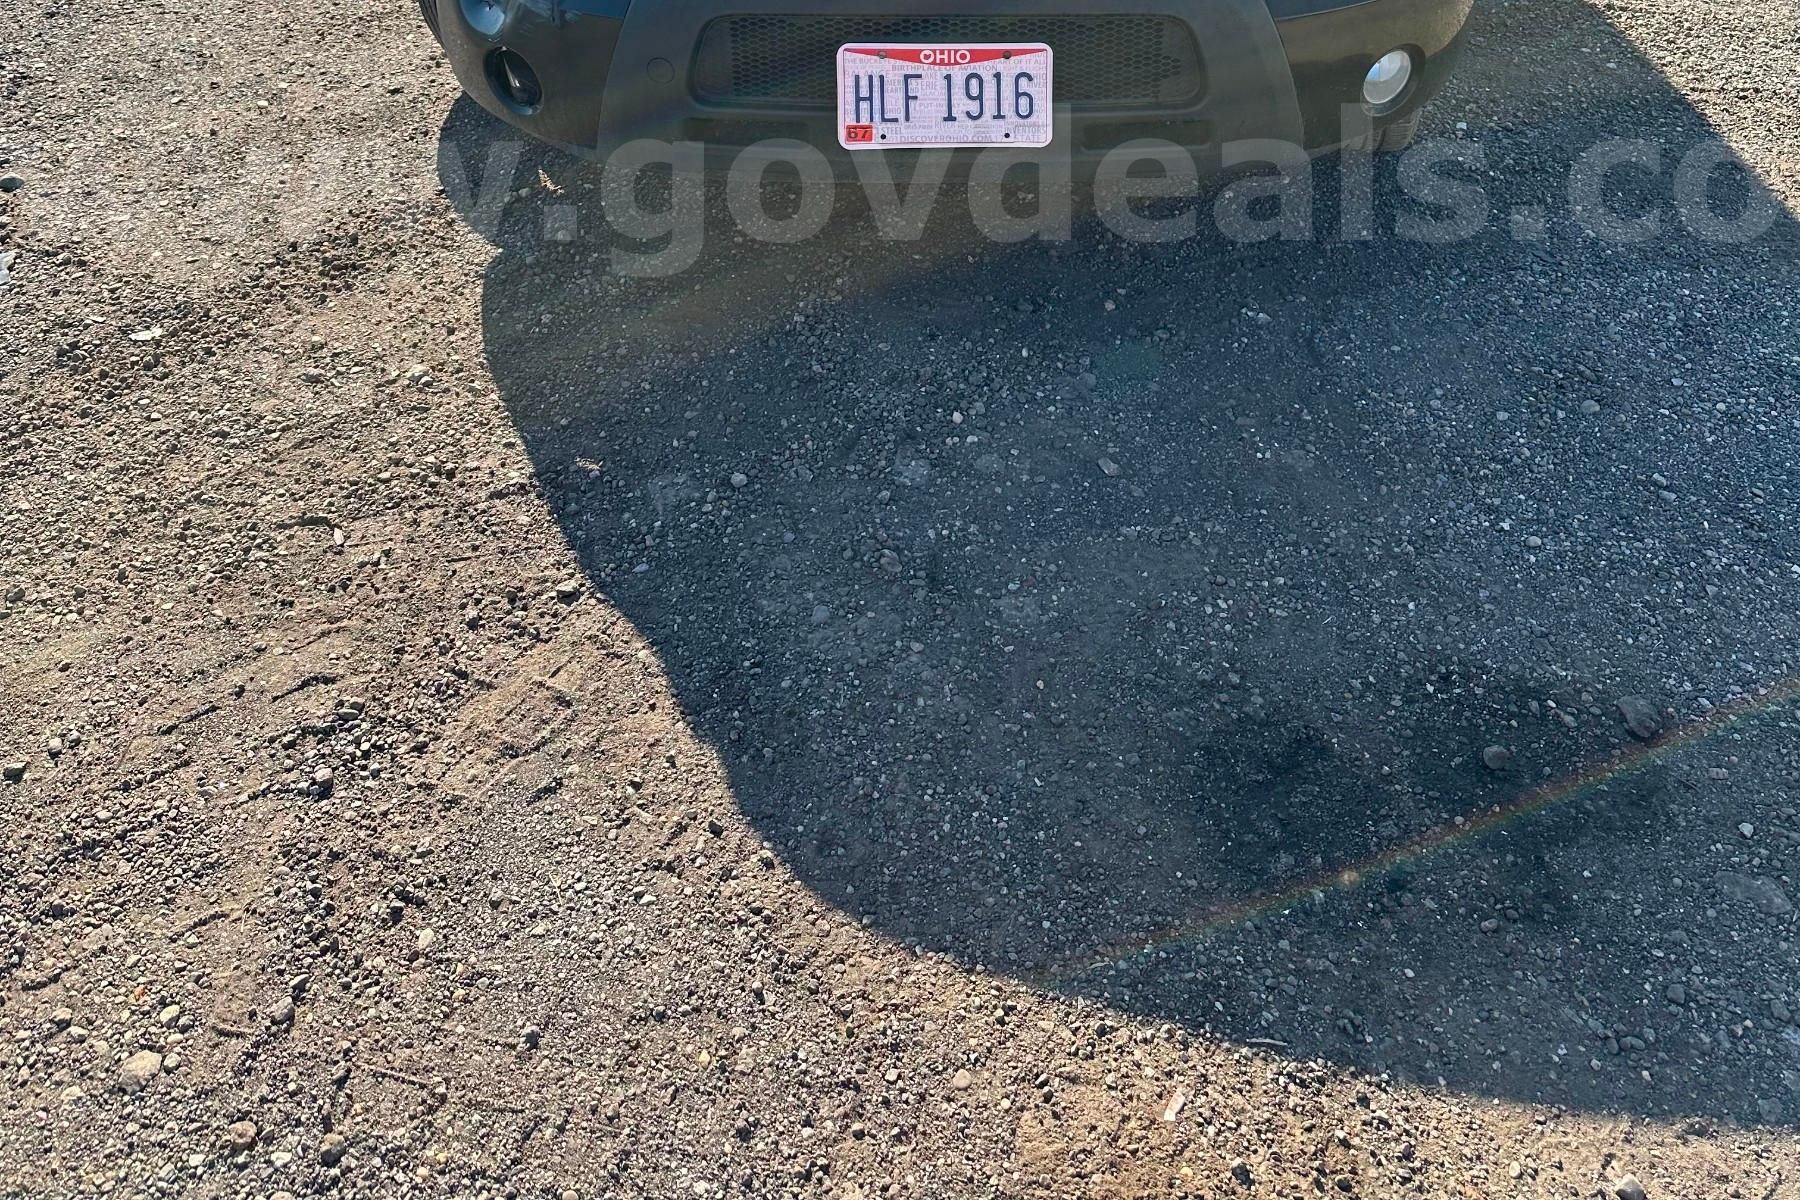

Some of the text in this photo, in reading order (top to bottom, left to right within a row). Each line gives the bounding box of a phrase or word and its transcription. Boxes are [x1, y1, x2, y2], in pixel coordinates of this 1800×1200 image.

[920, 49, 970, 64] OHIO
[855, 71, 1034, 123] HLF 1916
